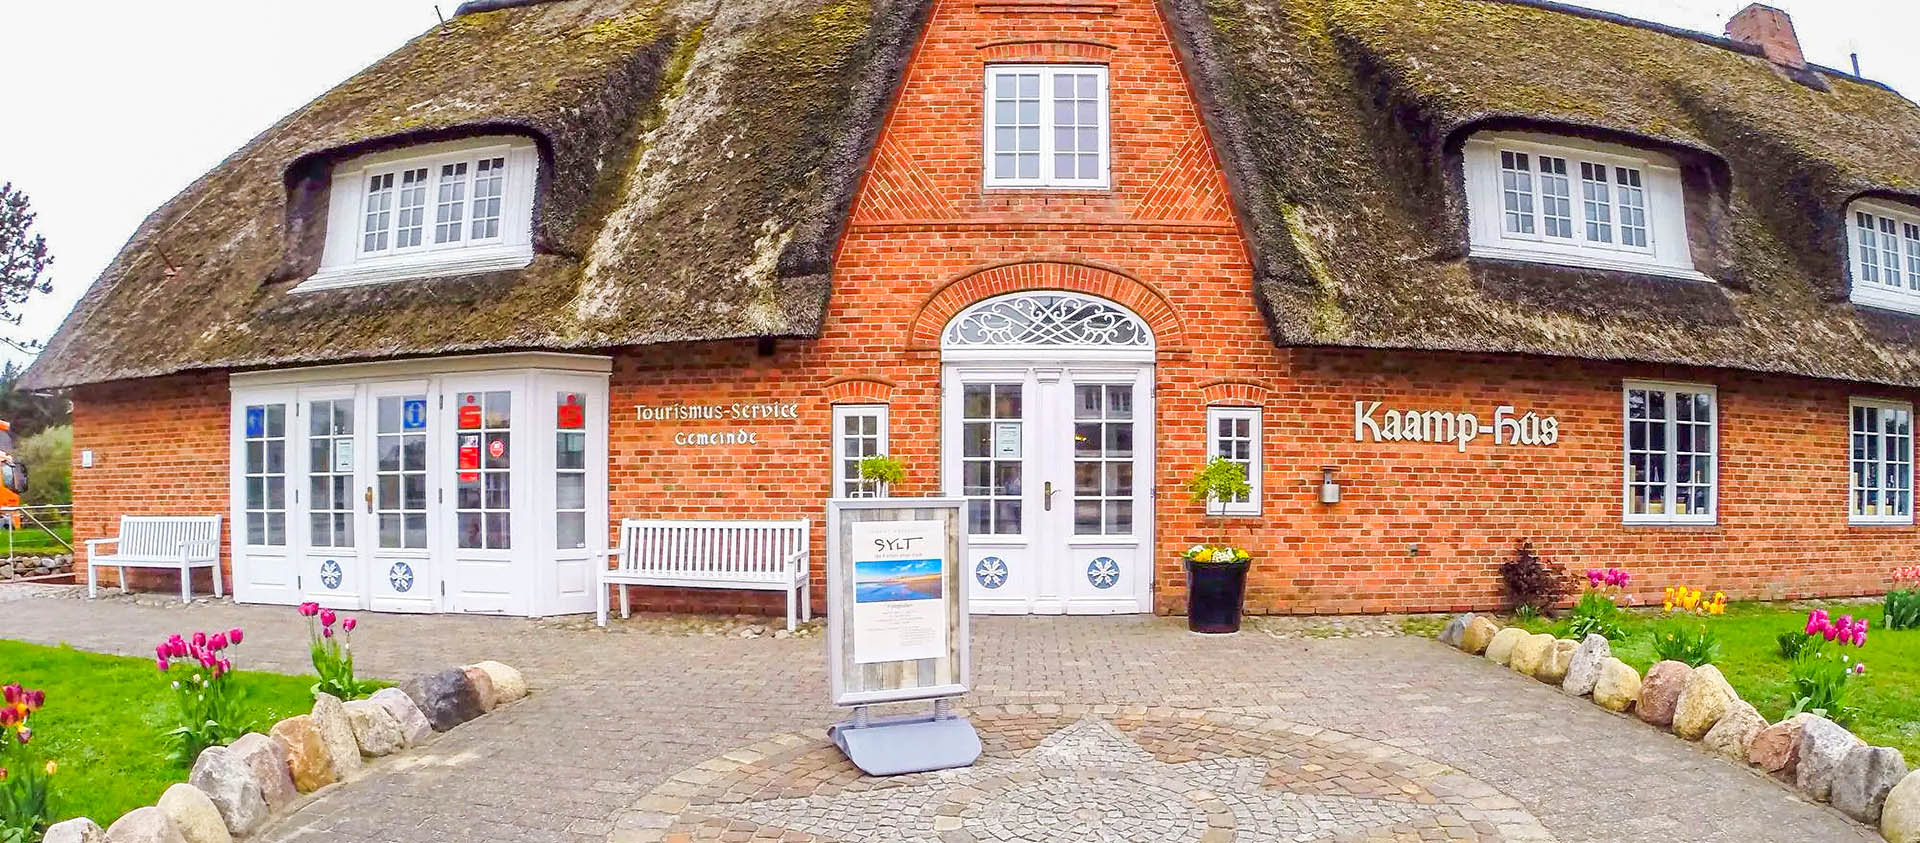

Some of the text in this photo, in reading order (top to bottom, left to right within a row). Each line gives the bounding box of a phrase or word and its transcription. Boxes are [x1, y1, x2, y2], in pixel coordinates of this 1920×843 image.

[634, 402, 799, 421] Tourismus-Service
[1354, 401, 1559, 453] Kaamp-Hüs
[674, 429, 758, 446] Gemeinde
[874, 537, 924, 552] SYLT
